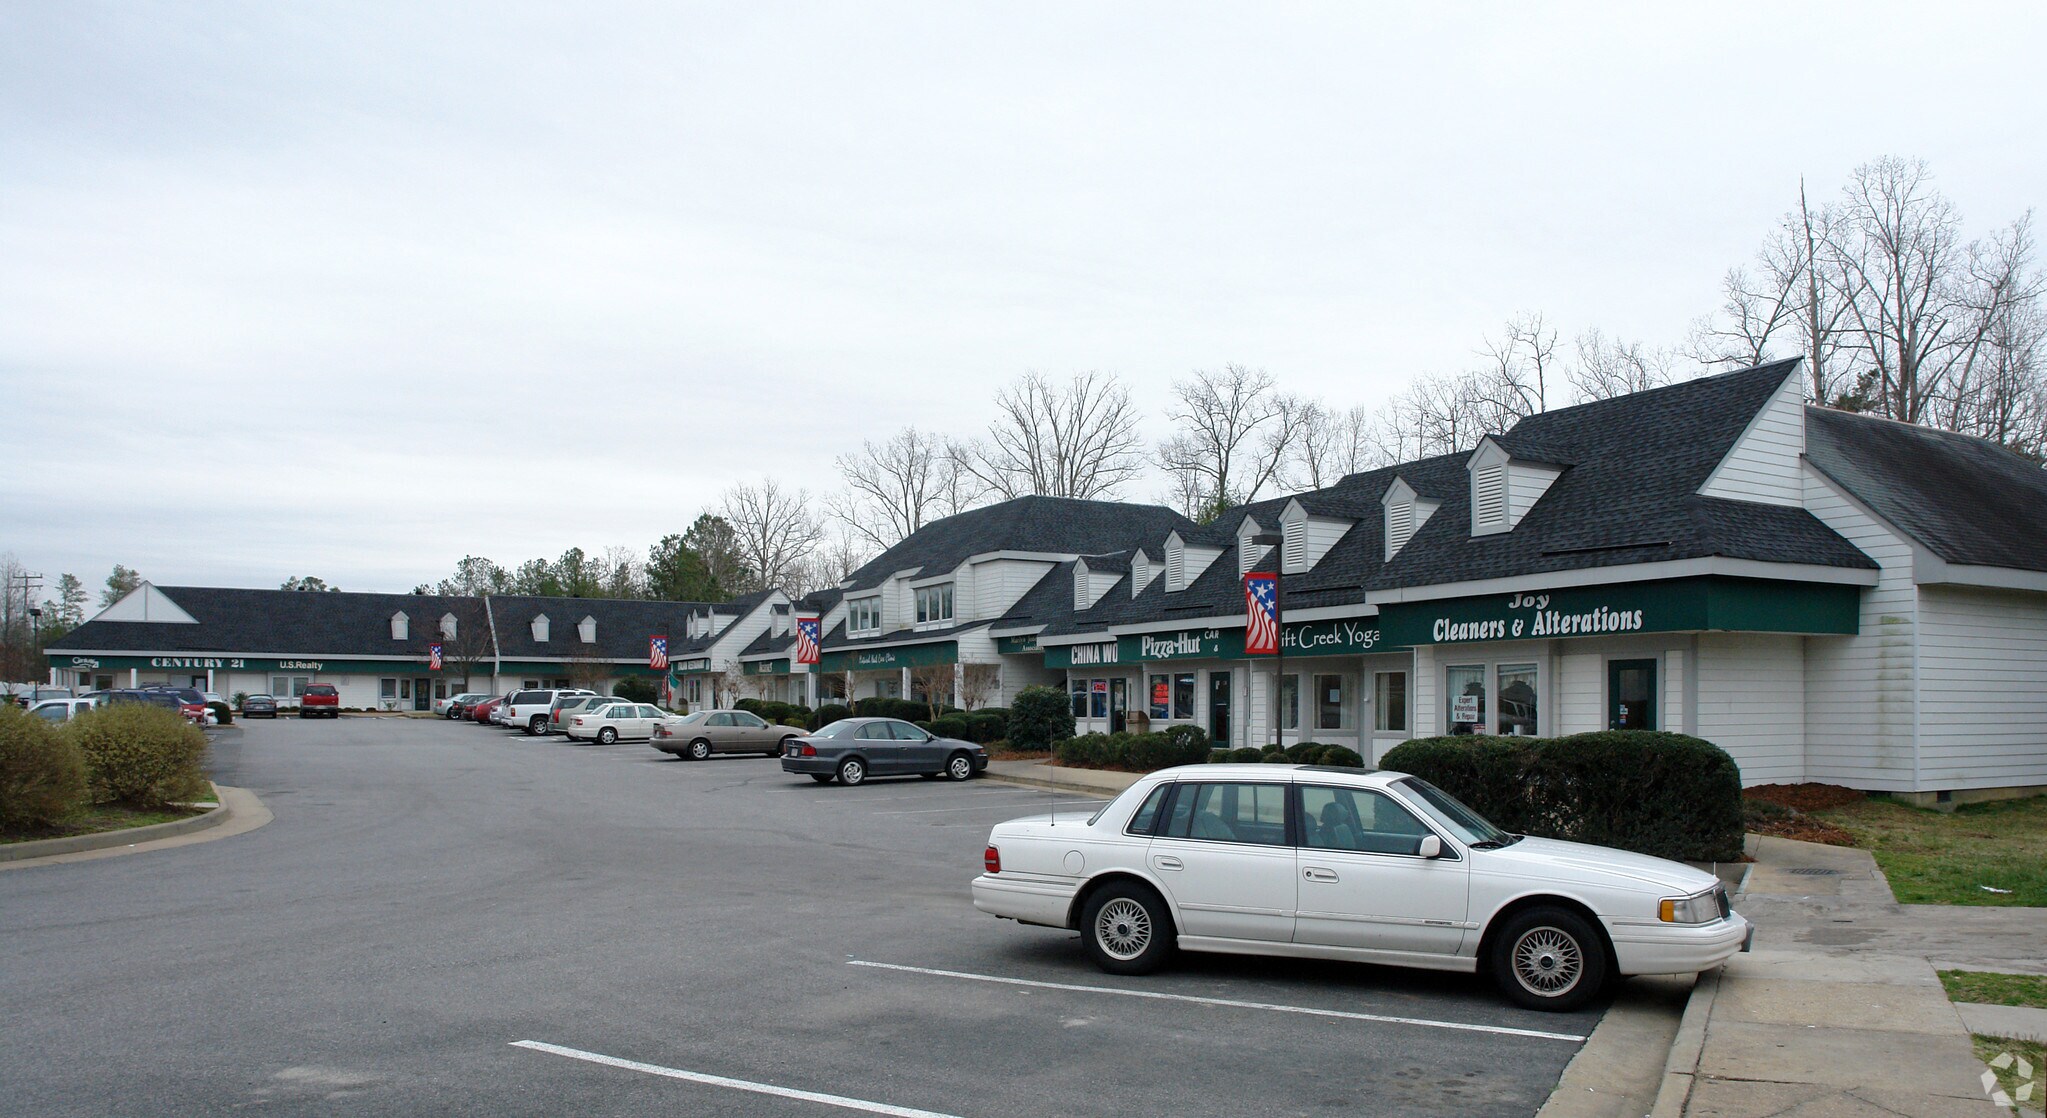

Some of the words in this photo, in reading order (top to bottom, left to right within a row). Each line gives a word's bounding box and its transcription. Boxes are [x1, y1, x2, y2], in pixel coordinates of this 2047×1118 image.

[1508, 594, 1550, 610] Joy
[1433, 618, 1505, 642] Cleaners
[1511, 618, 1524, 637] &
[1531, 606, 1643, 636] Alterations
[1281, 628, 1296, 647] ift
[1298, 623, 1342, 649] Creek
[1344, 622, 1380, 649] Yoga
[151, 657, 225, 668] CENTURY
[231, 659, 244, 668] 21
[1071, 644, 1100, 665] CHINA
[1454, 704, 1477, 712] Alterations
[1458, 696, 1473, 704] Expert
